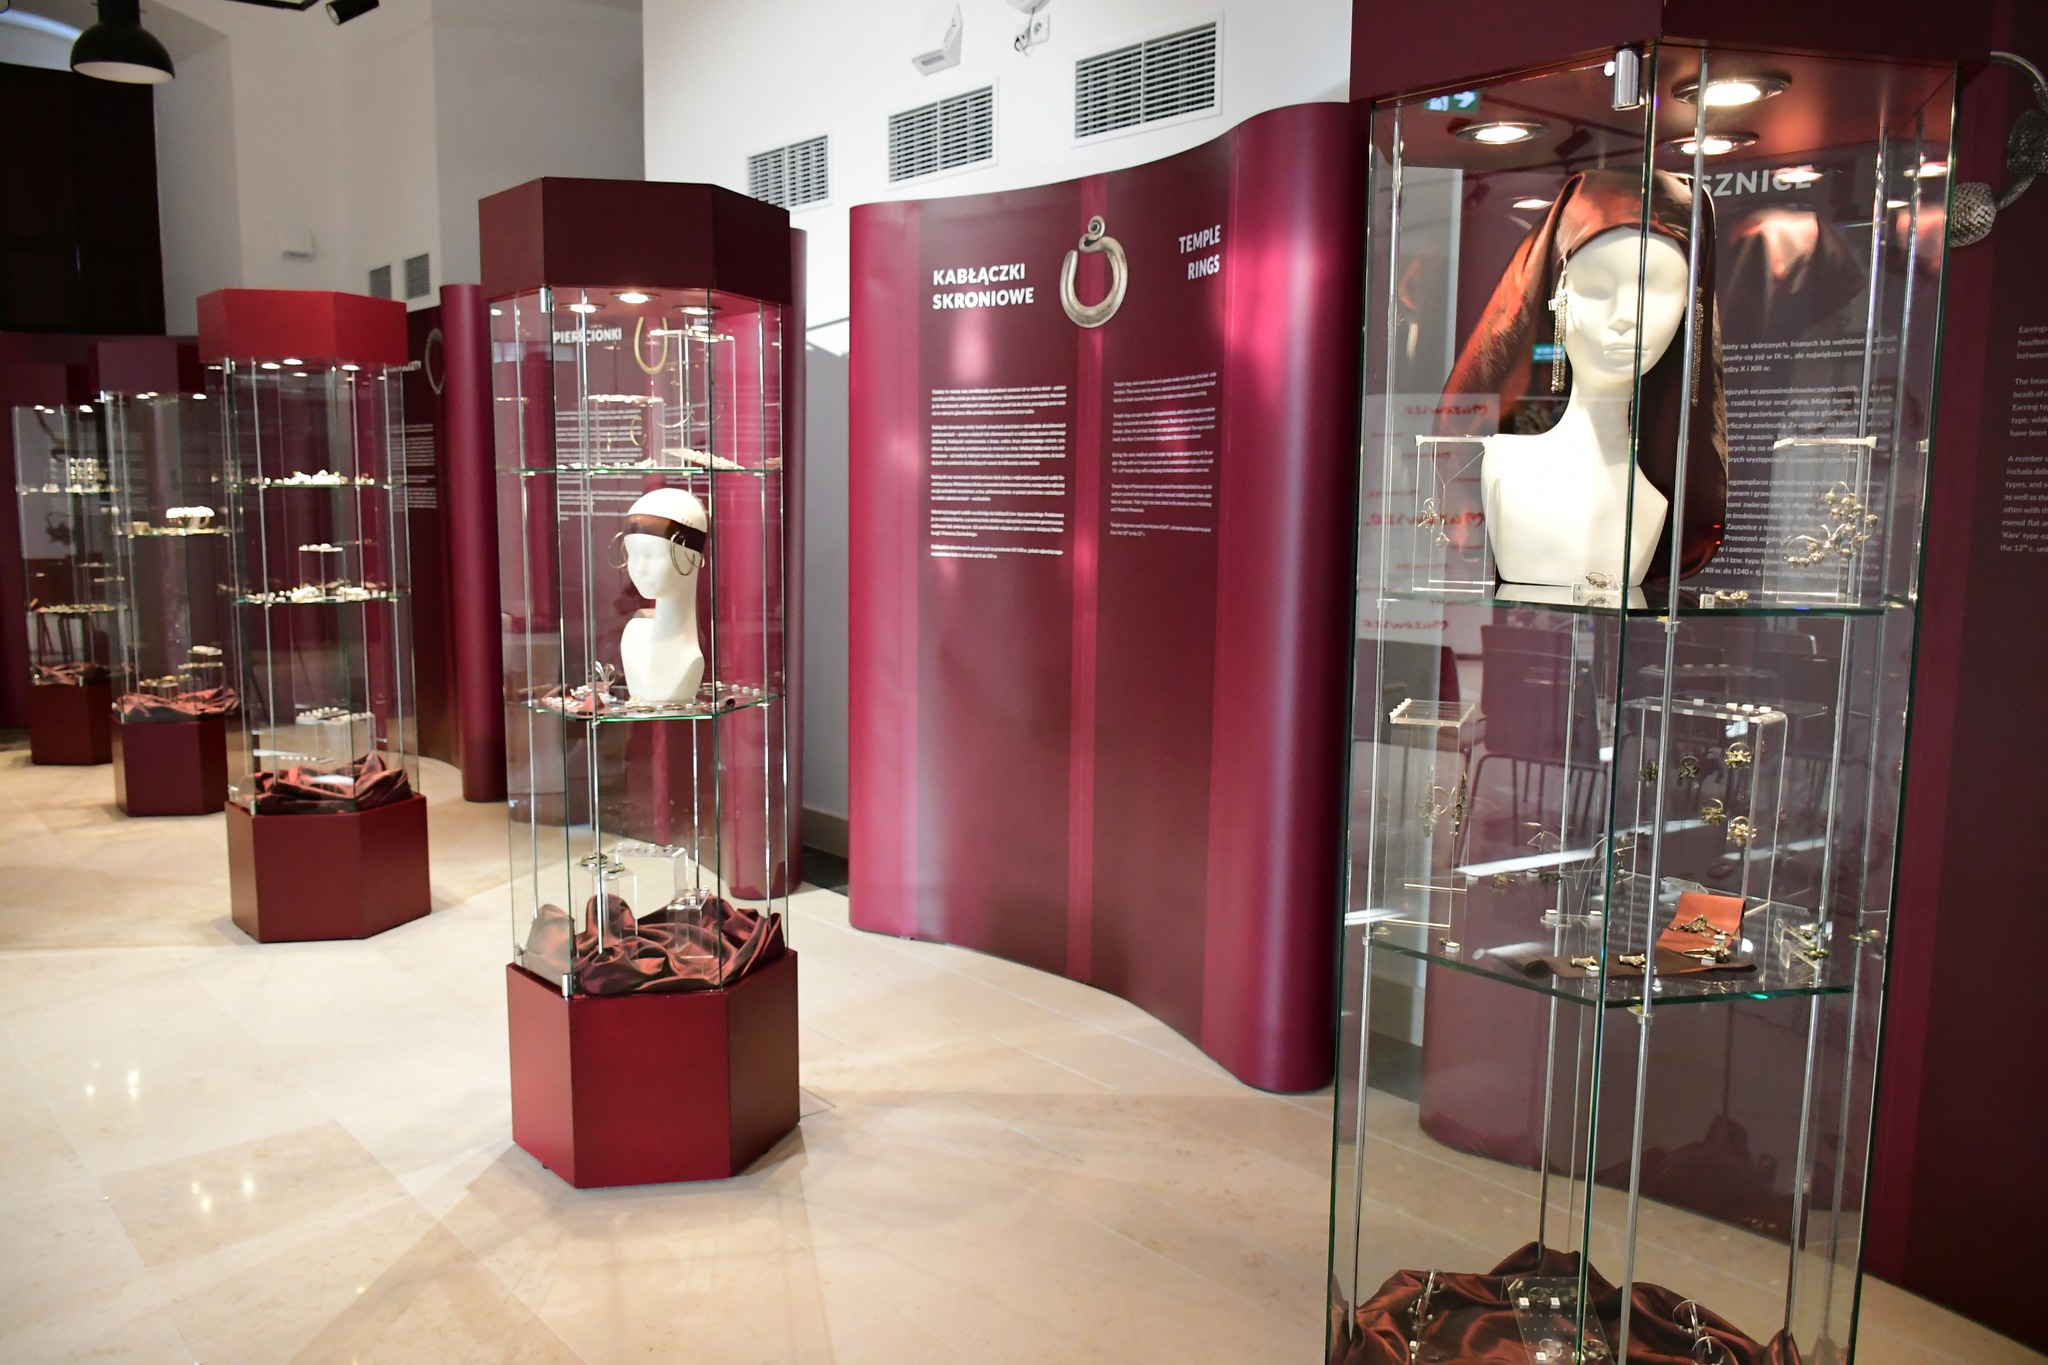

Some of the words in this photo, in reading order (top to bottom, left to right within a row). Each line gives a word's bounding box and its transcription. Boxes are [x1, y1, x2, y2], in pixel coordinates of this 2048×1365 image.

[1179, 224, 1221, 254] TEMPLE
[933, 263, 1025, 285] KABŁĄCZKI
[1188, 254, 1220, 280] RINGS
[933, 287, 1034, 309] SKRONIOWE
[1820, 338, 1831, 346] lub
[1833, 337, 1868, 345] wełnianyc
[2010, 429, 2028, 437] have
[2015, 455, 2043, 463] number
[1733, 567, 1750, 575] 1240
